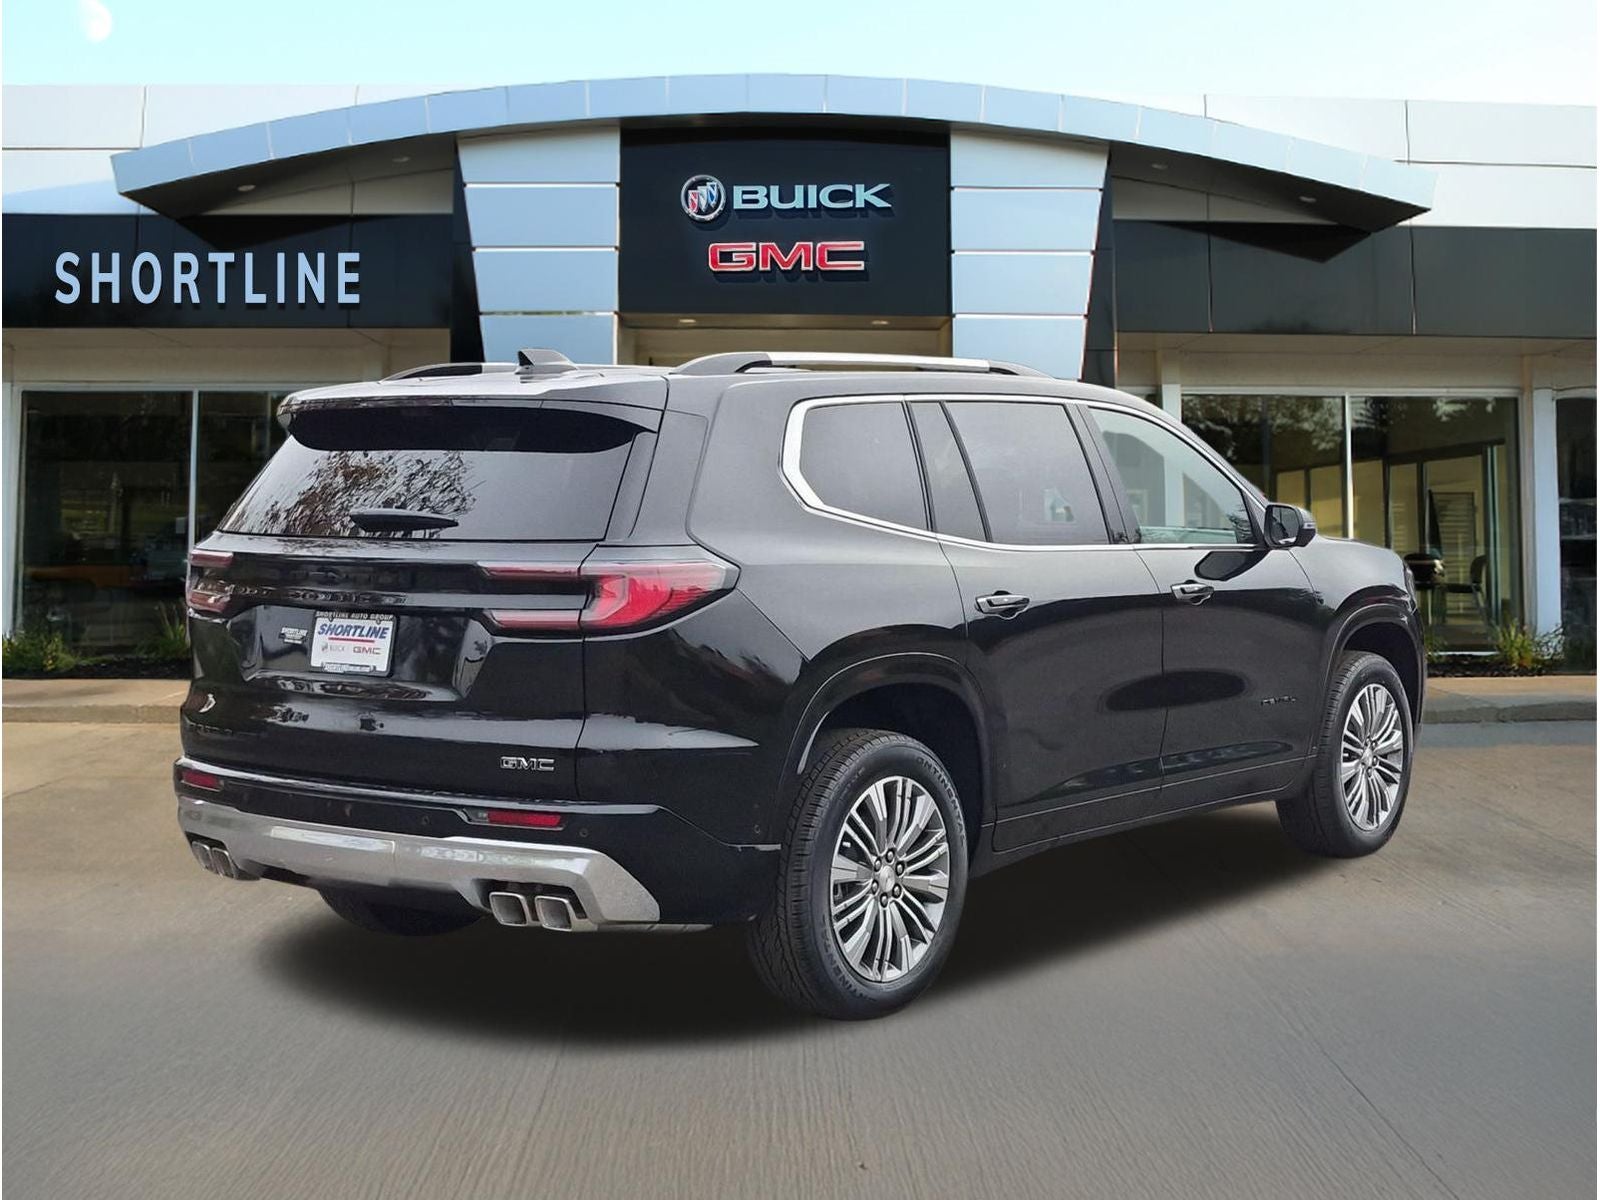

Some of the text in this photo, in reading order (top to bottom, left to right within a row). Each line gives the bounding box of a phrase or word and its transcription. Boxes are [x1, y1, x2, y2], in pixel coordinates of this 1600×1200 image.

[732, 183, 892, 210] BUICK
[708, 240, 866, 272] GMC
[54, 251, 361, 304] SHORTLINE
[318, 623, 389, 639] SHORTLINE
[353, 645, 382, 655] GMC
[500, 756, 555, 771] GMC
